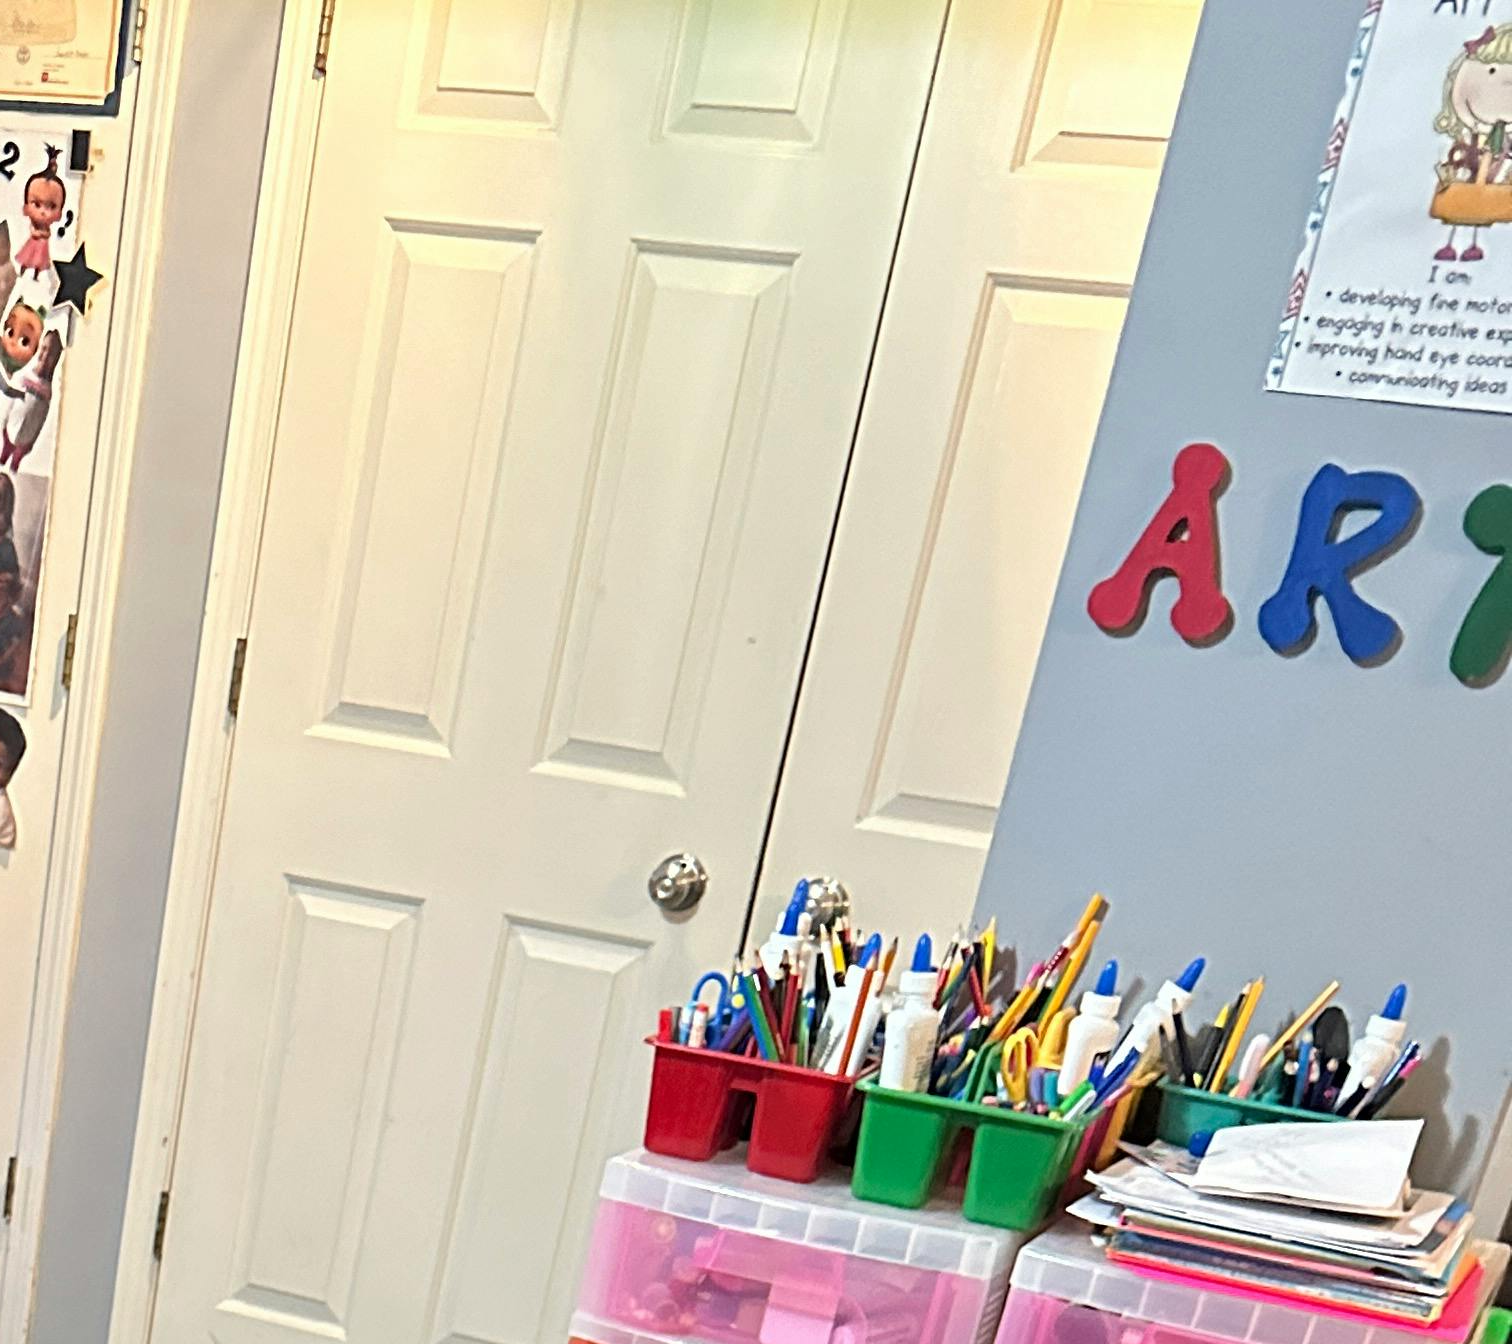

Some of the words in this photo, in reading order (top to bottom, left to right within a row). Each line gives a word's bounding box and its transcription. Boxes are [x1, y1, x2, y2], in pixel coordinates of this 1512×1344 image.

[1340, 288, 1421, 315] developing
[1430, 294, 1458, 311] fine
[1317, 313, 1384, 338] engaging
[1409, 321, 1478, 339] creative
[1307, 336, 1378, 365] improving
[1385, 345, 1424, 362] hand
[1430, 350, 1458, 369] eye
[1349, 370, 1458, 397] communicating
[1464, 377, 1508, 394] ideas
